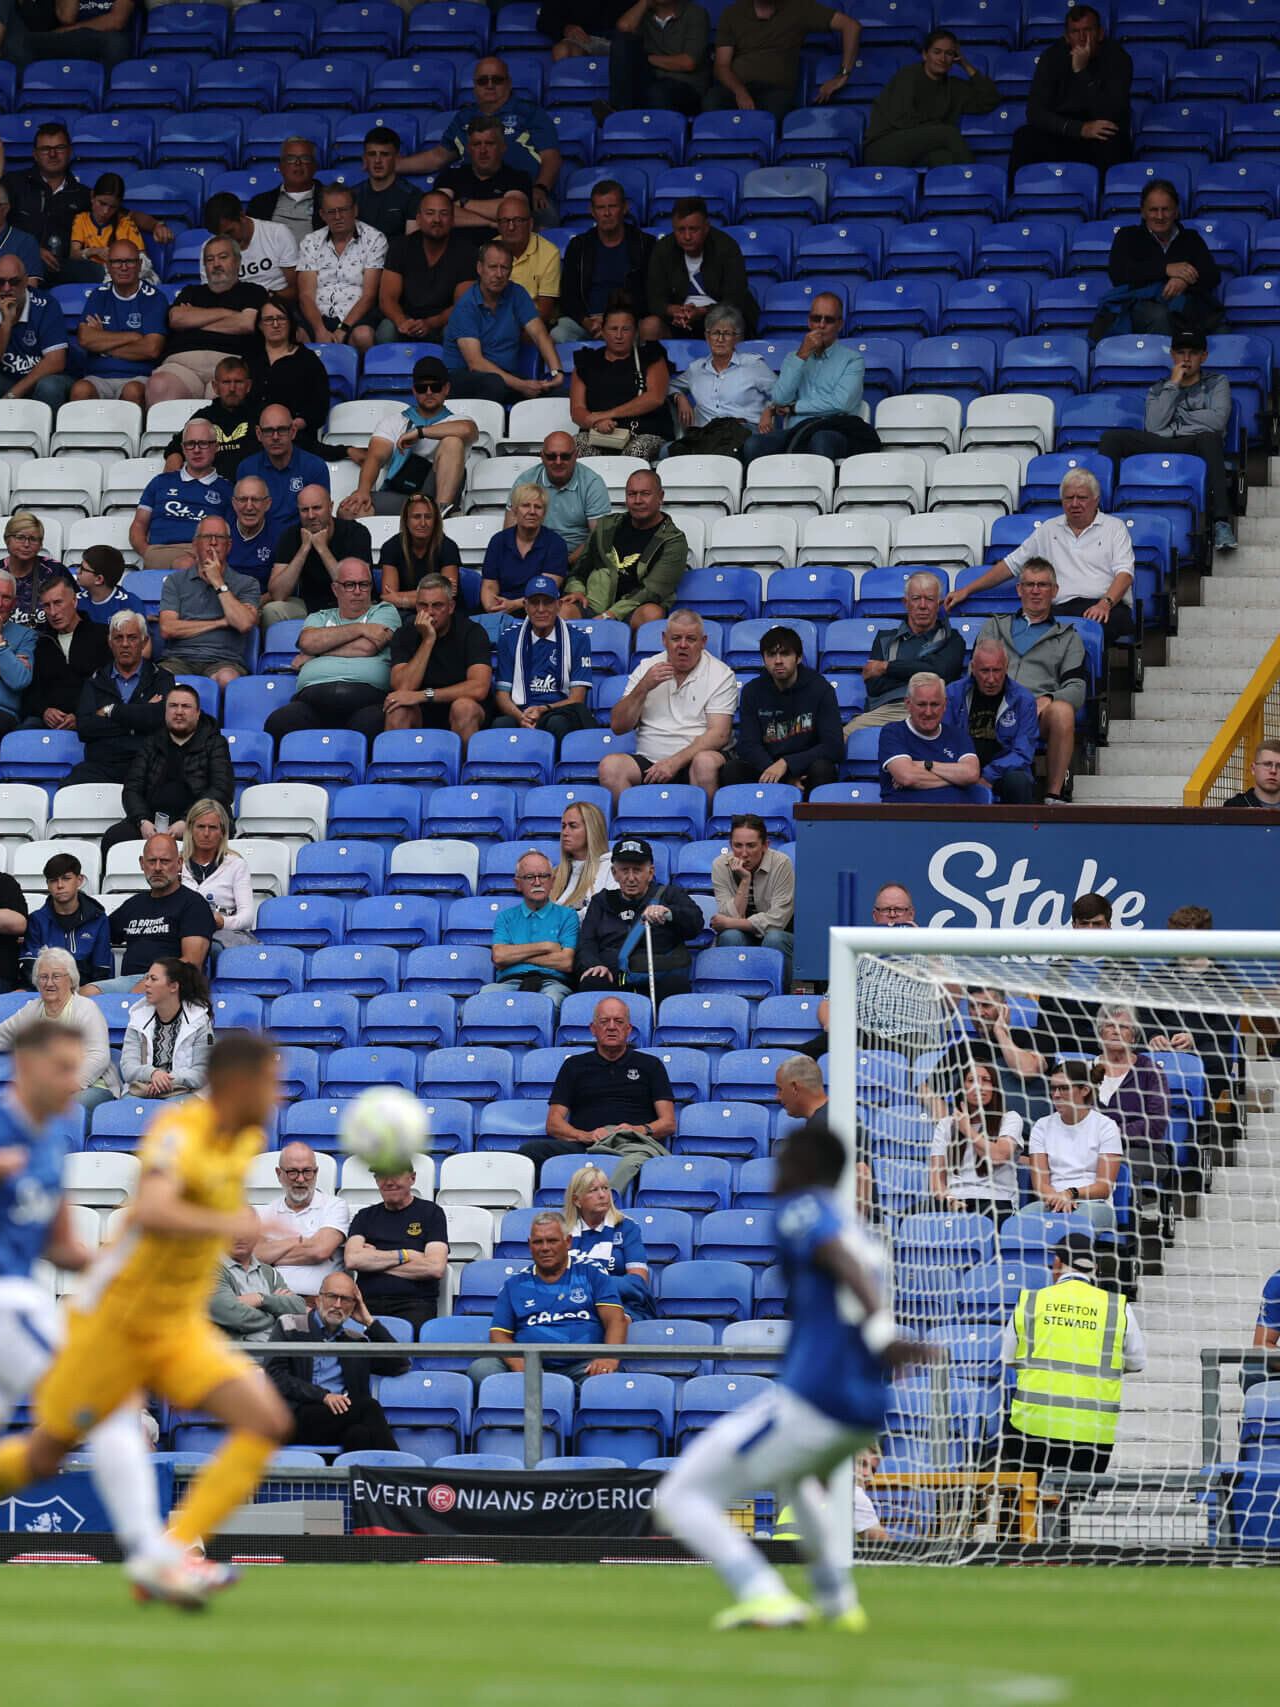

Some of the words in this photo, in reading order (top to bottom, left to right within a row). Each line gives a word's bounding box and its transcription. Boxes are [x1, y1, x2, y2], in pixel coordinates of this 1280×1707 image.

[927, 841, 1147, 930] Stake
[1045, 1303, 1098, 1317] EVERTON
[1043, 1316, 1097, 1331] STEWARD
